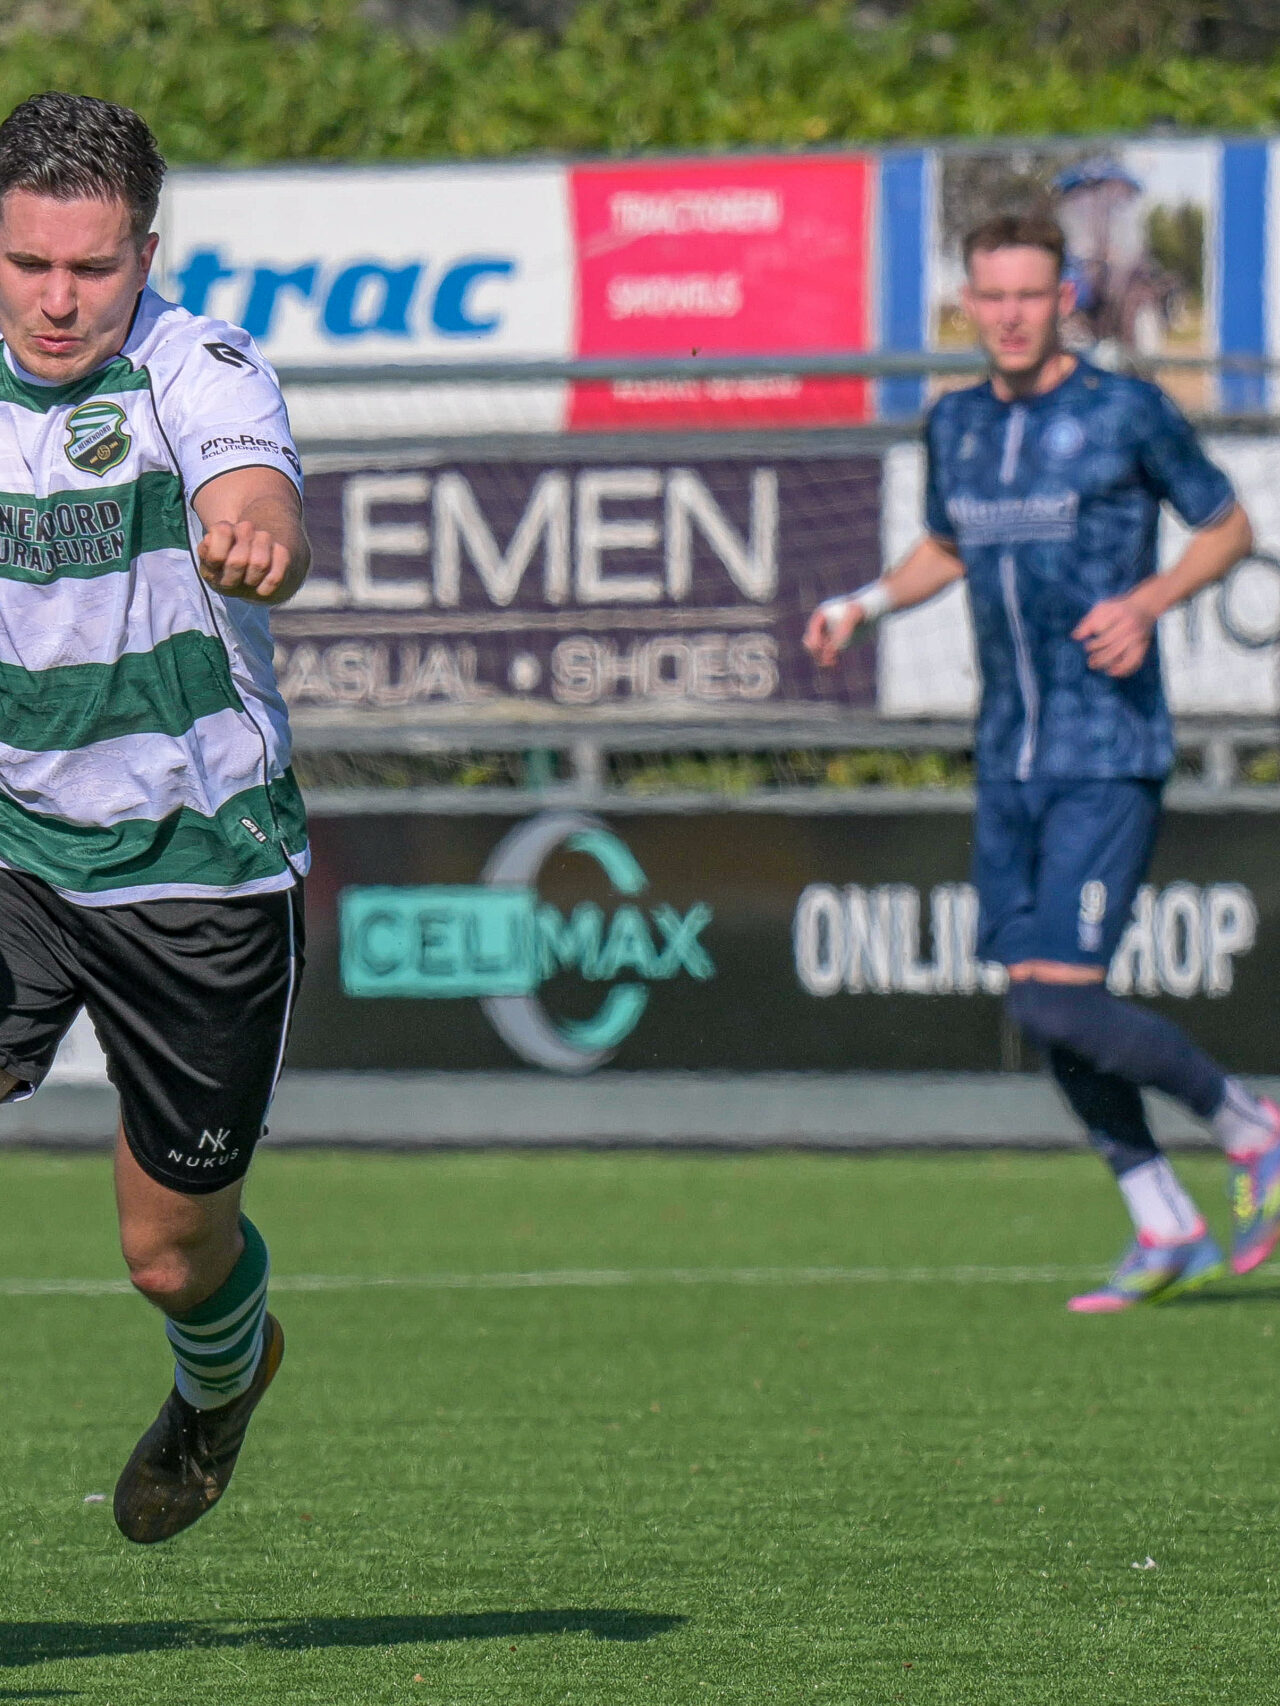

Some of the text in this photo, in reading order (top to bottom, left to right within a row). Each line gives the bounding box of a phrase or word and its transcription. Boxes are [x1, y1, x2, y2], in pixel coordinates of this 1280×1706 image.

[200, 434, 280, 455] Pro-Rec
[201, 444, 261, 461] SOLUTIONS
[551, 634, 780, 703] SHOES
[167, 1148, 240, 1168] NUKUS
